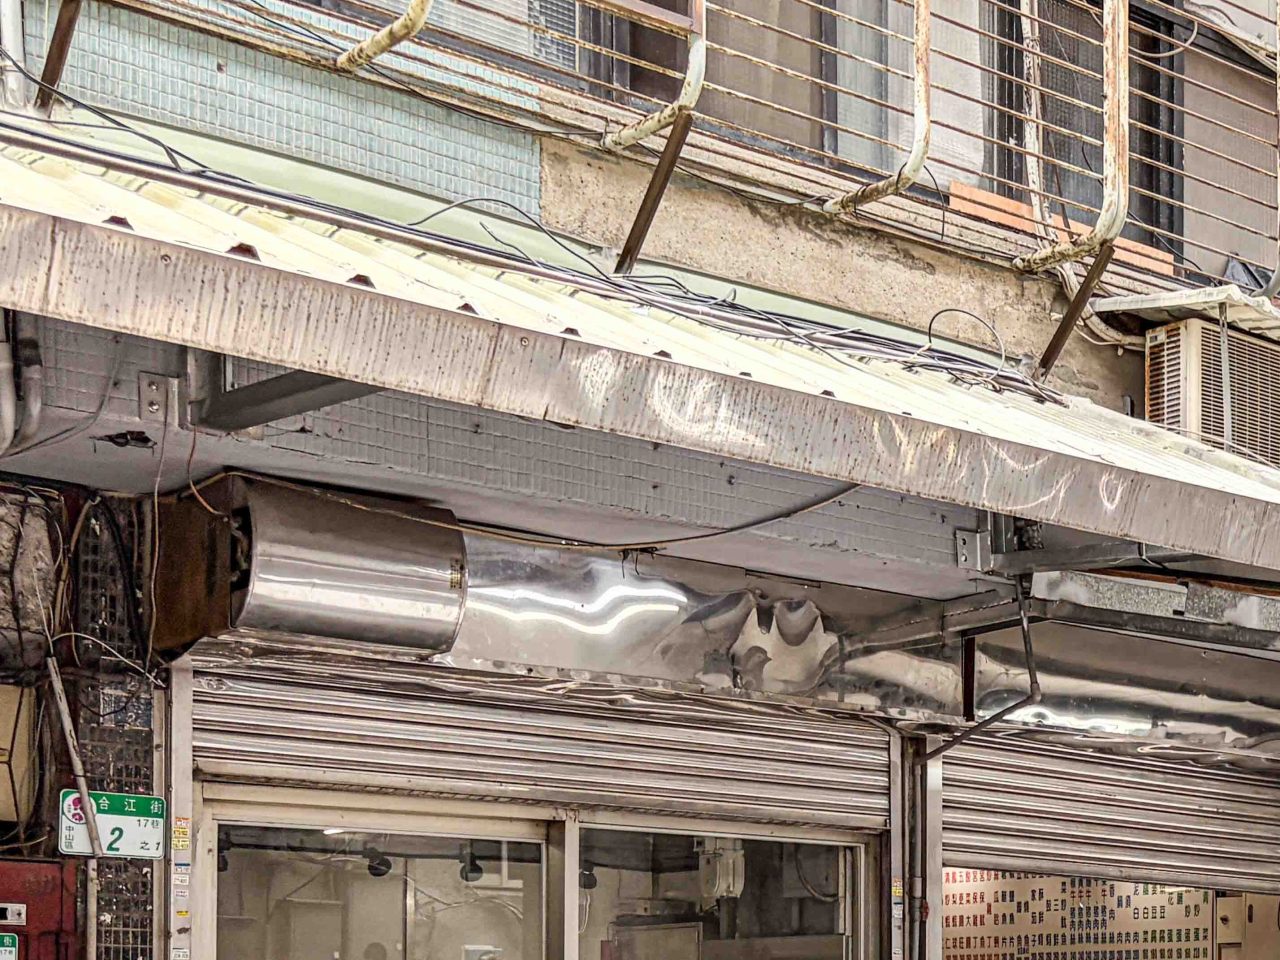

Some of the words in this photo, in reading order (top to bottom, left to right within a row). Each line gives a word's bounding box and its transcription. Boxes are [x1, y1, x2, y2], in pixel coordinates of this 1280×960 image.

[98, 796, 162, 814] 合江街
[106, 826, 124, 852] 2
